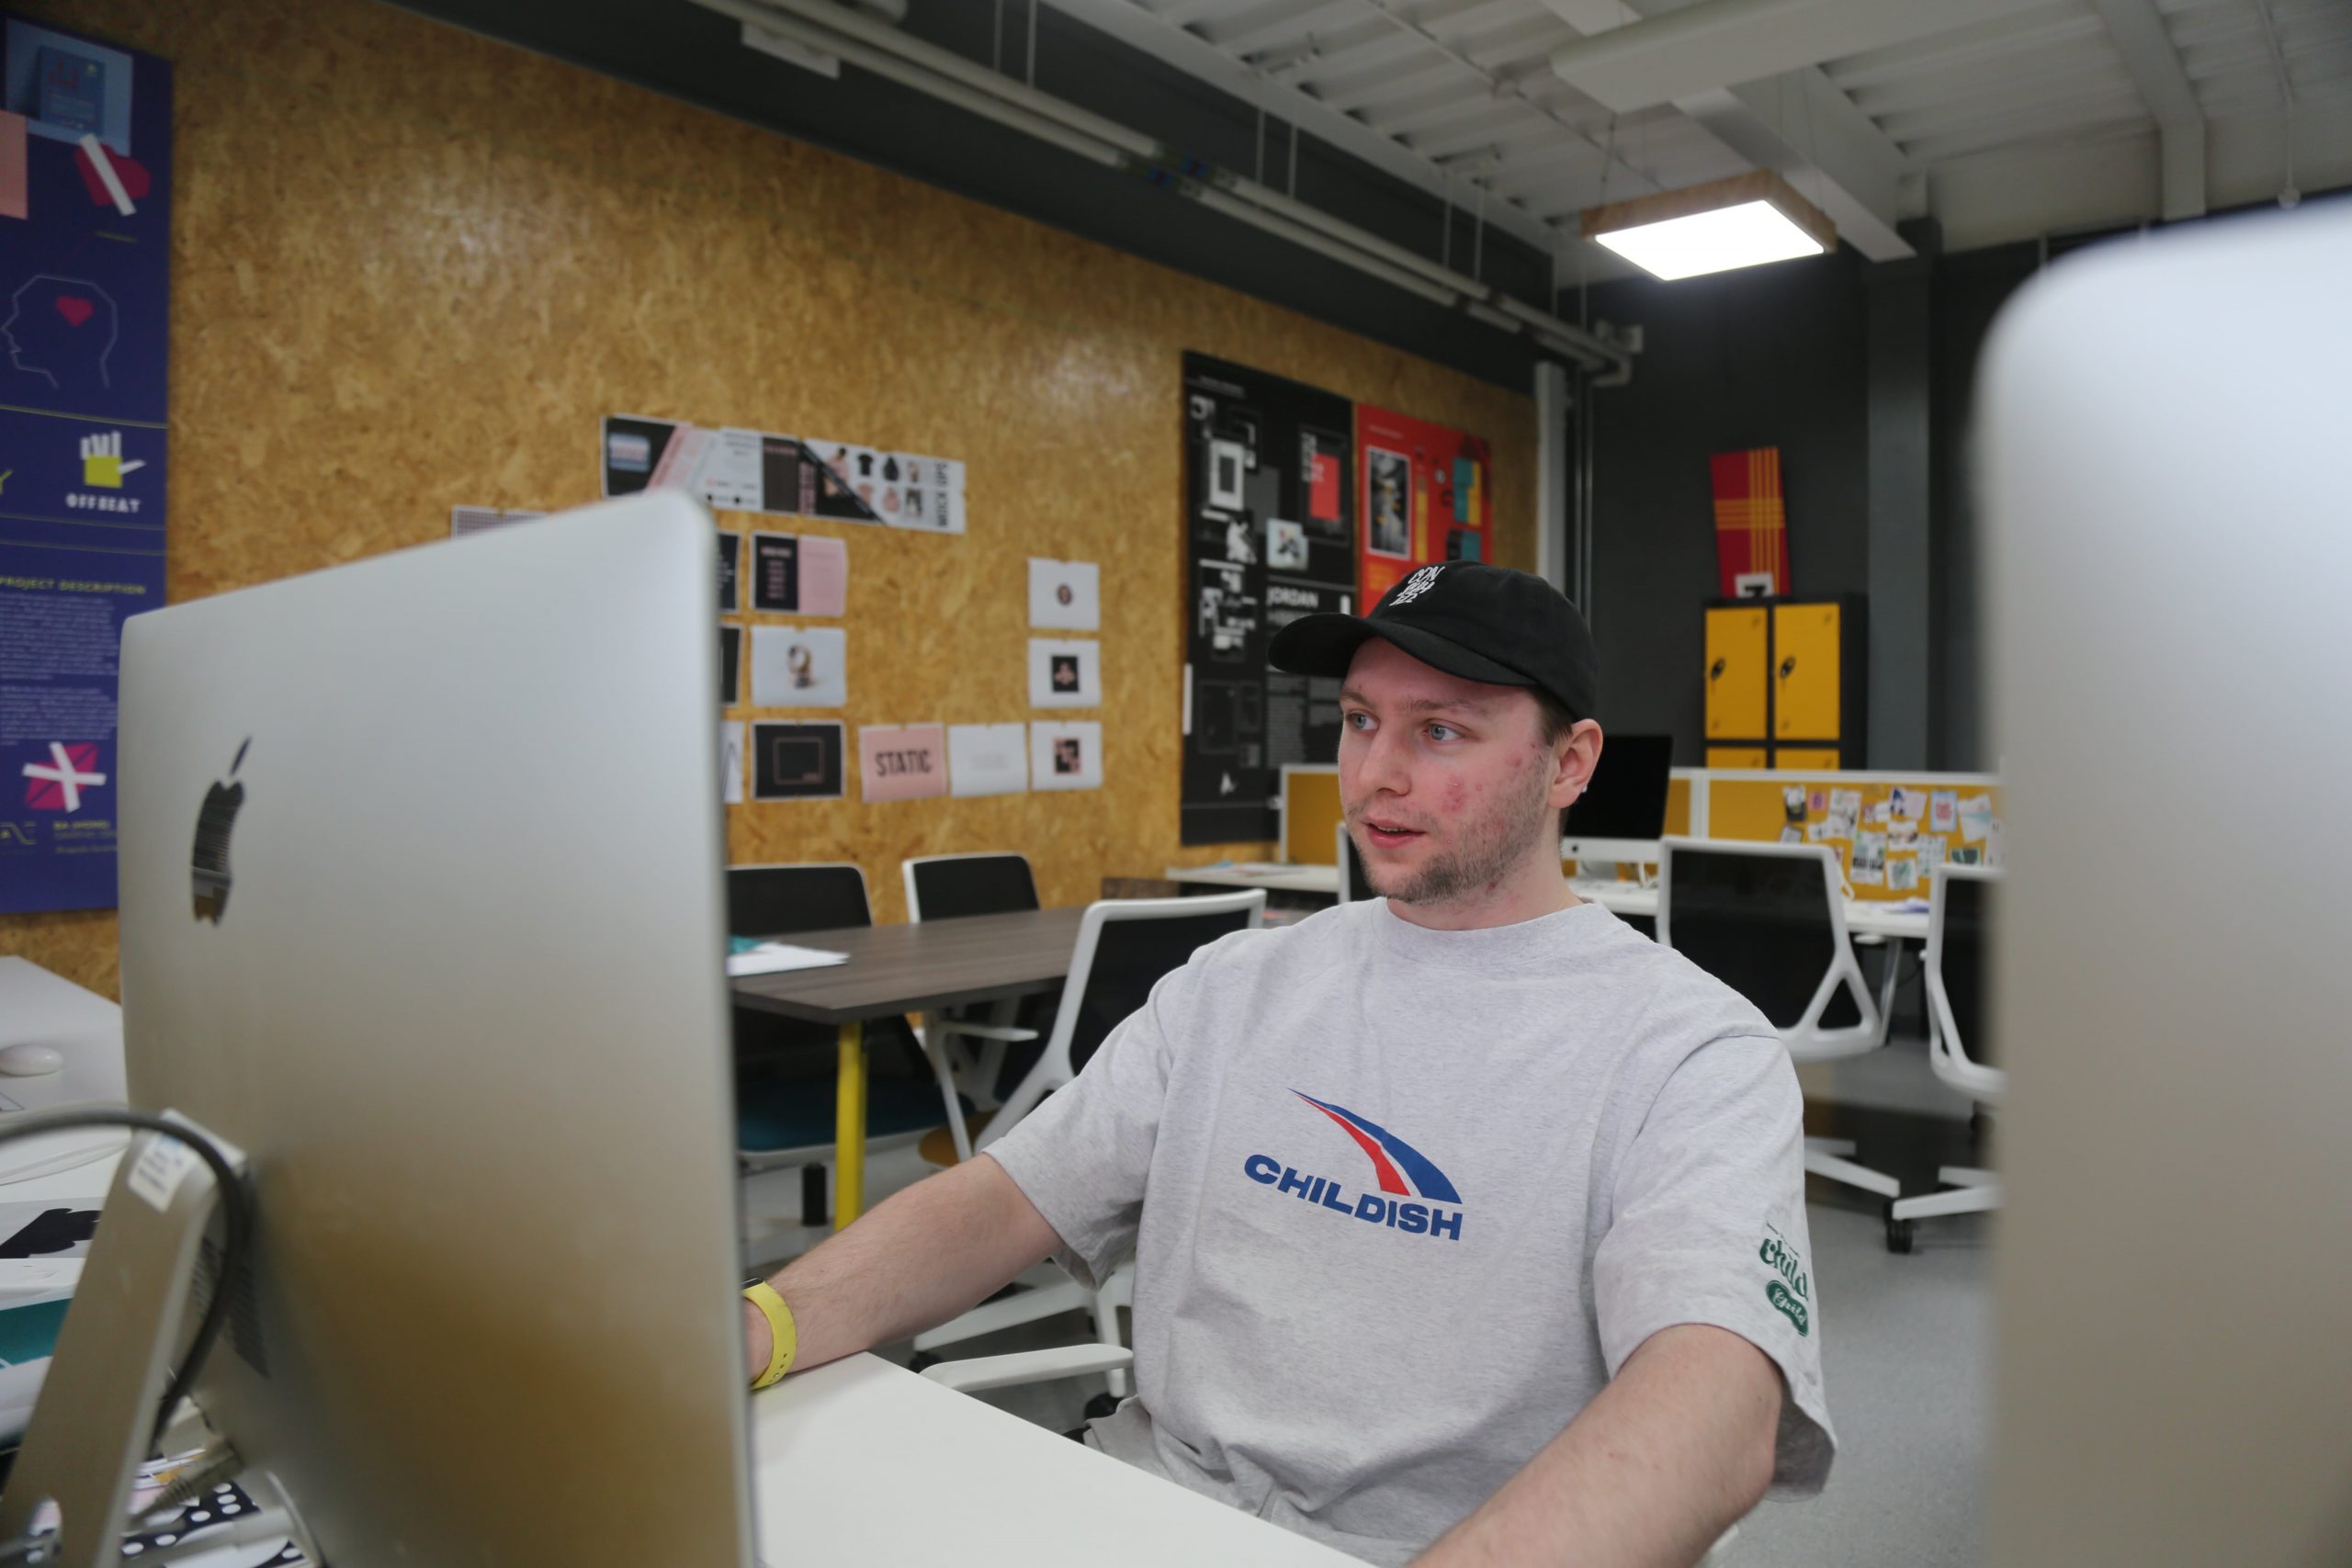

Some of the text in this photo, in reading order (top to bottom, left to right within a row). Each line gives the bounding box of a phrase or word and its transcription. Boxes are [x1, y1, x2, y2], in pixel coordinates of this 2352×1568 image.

[66, 493, 141, 513] OFFBEAT
[0, 577, 146, 594] PROJECT DESCRIPTION
[876, 749, 931, 777] STATIC
[1244, 1154, 1463, 1241] CHILDISH
